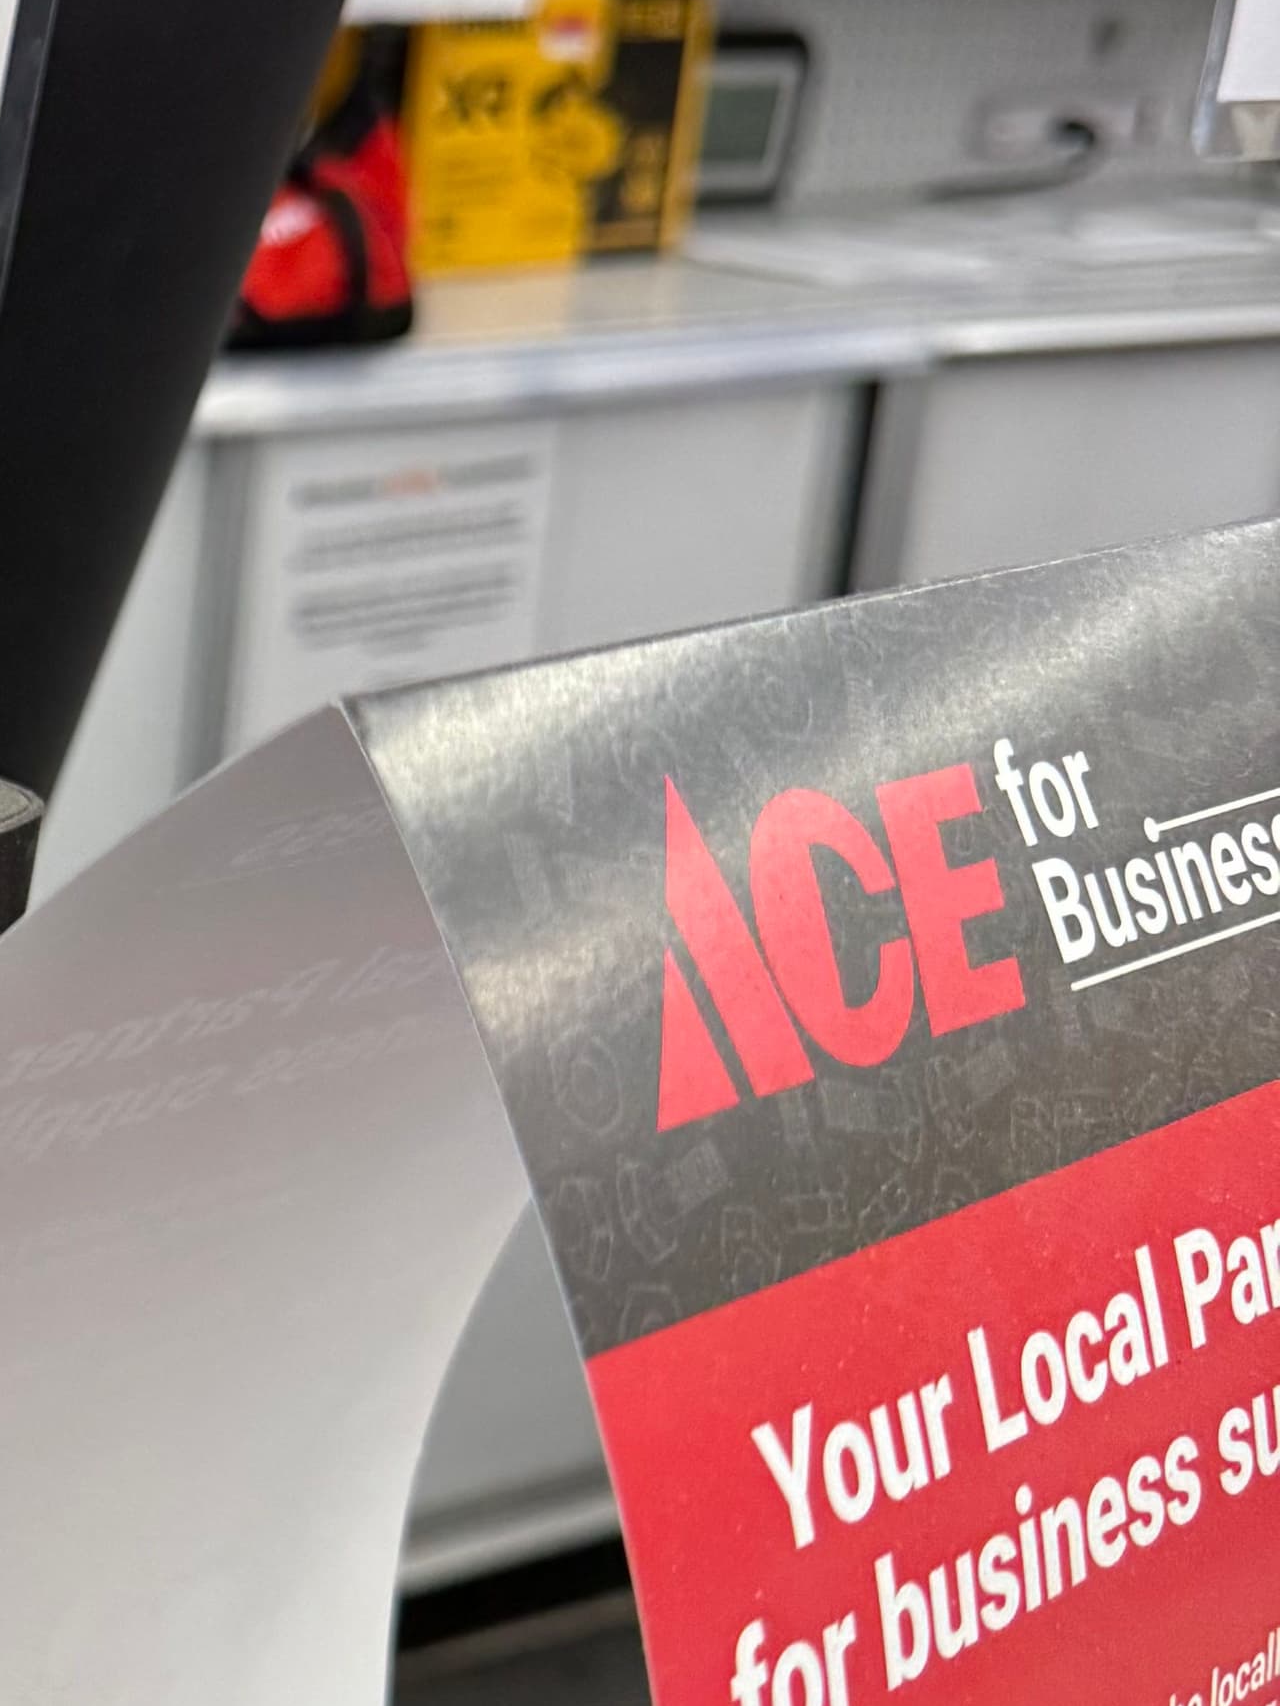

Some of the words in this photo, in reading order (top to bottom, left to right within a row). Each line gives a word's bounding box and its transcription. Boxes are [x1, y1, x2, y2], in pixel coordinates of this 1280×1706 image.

[993, 738, 1100, 848] for
[1031, 813, 1280, 964] Busines
[656, 762, 1027, 1133] ACE
[750, 1373, 953, 1550] Your
[966, 1244, 1170, 1453] Local
[873, 1435, 1203, 1692] business
